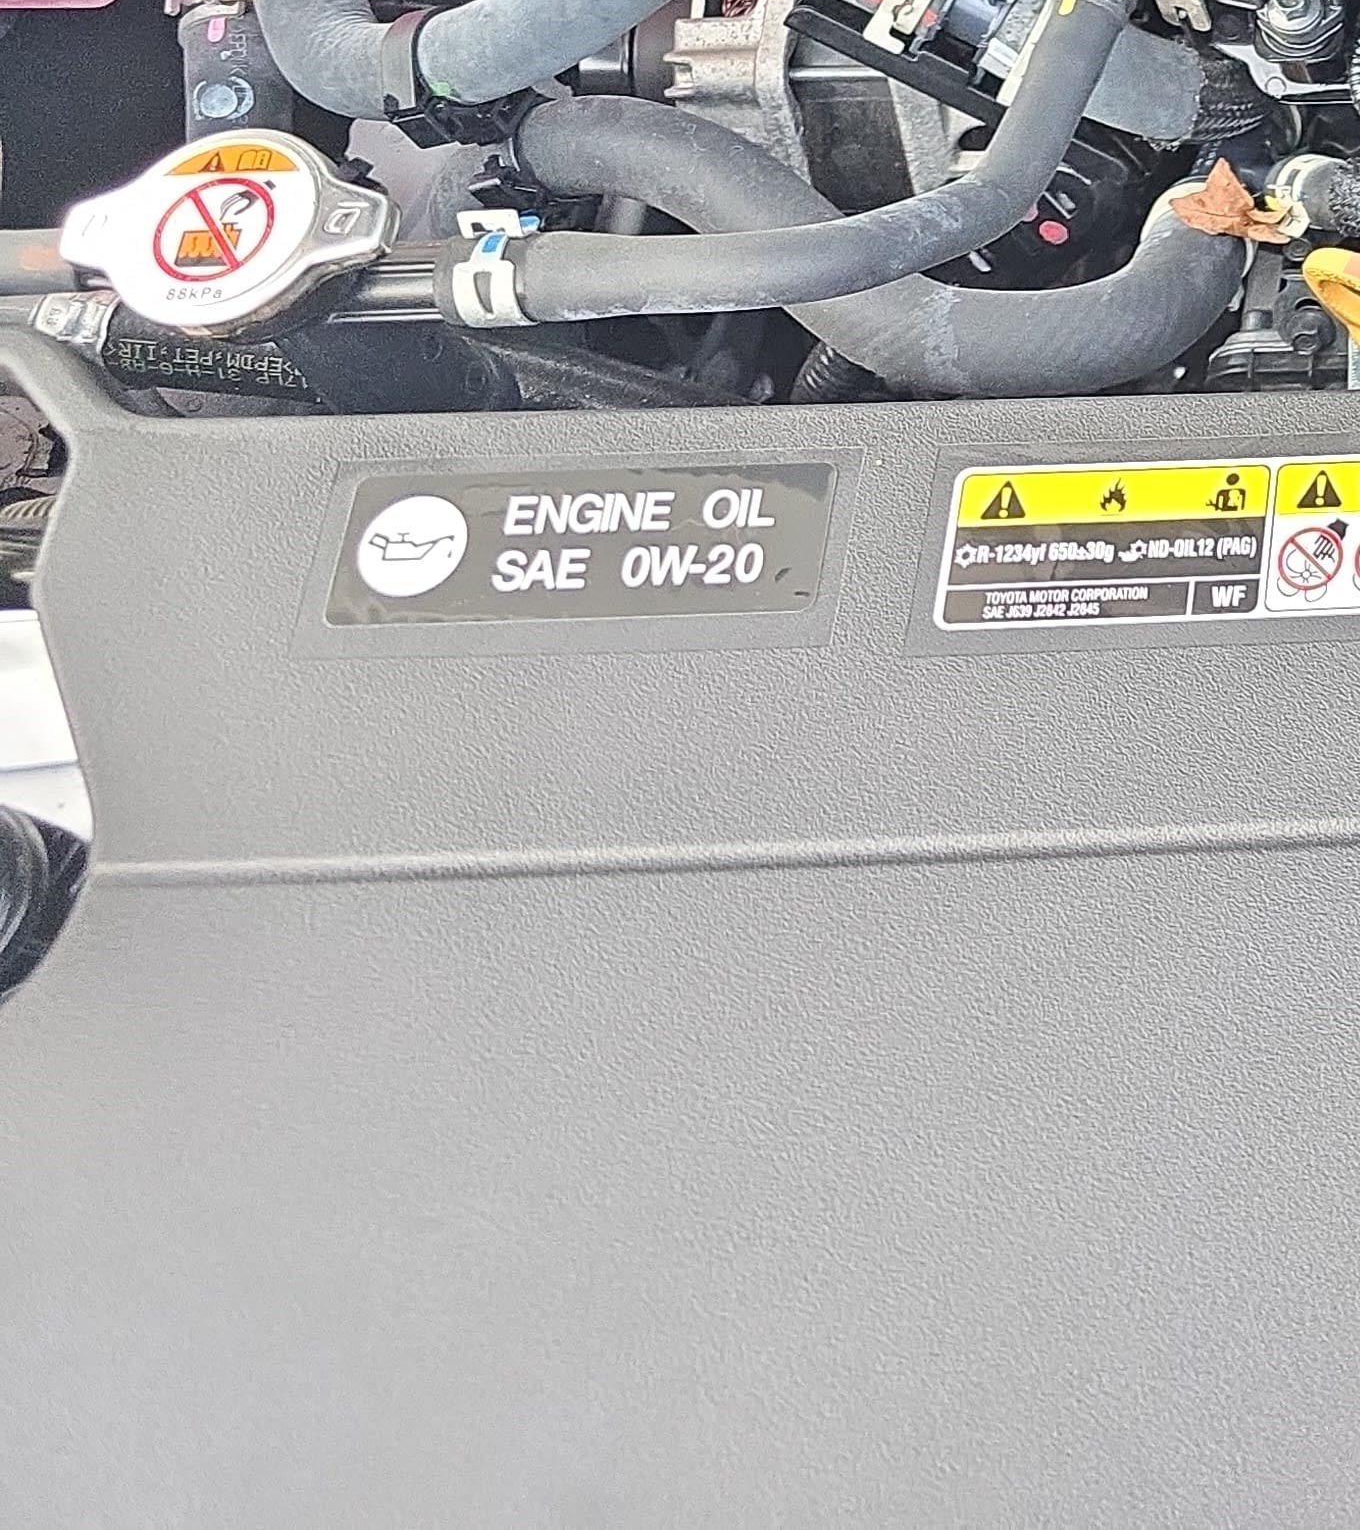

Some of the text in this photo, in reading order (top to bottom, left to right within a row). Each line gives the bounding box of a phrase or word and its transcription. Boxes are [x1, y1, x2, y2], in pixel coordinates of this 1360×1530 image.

[166, 286, 222, 301] 88kPa
[502, 488, 776, 536] ENGINE OIL
[976, 545, 1047, 566] R-1234yf
[1216, 536, 1258, 559] (PAG)
[491, 544, 764, 592] SAE 0W-20
[985, 586, 1149, 605] TOYOTA MOTOR CORPORATION
[1210, 584, 1248, 609] WF
[982, 602, 1101, 619] SAE J639 J2842 J2845
